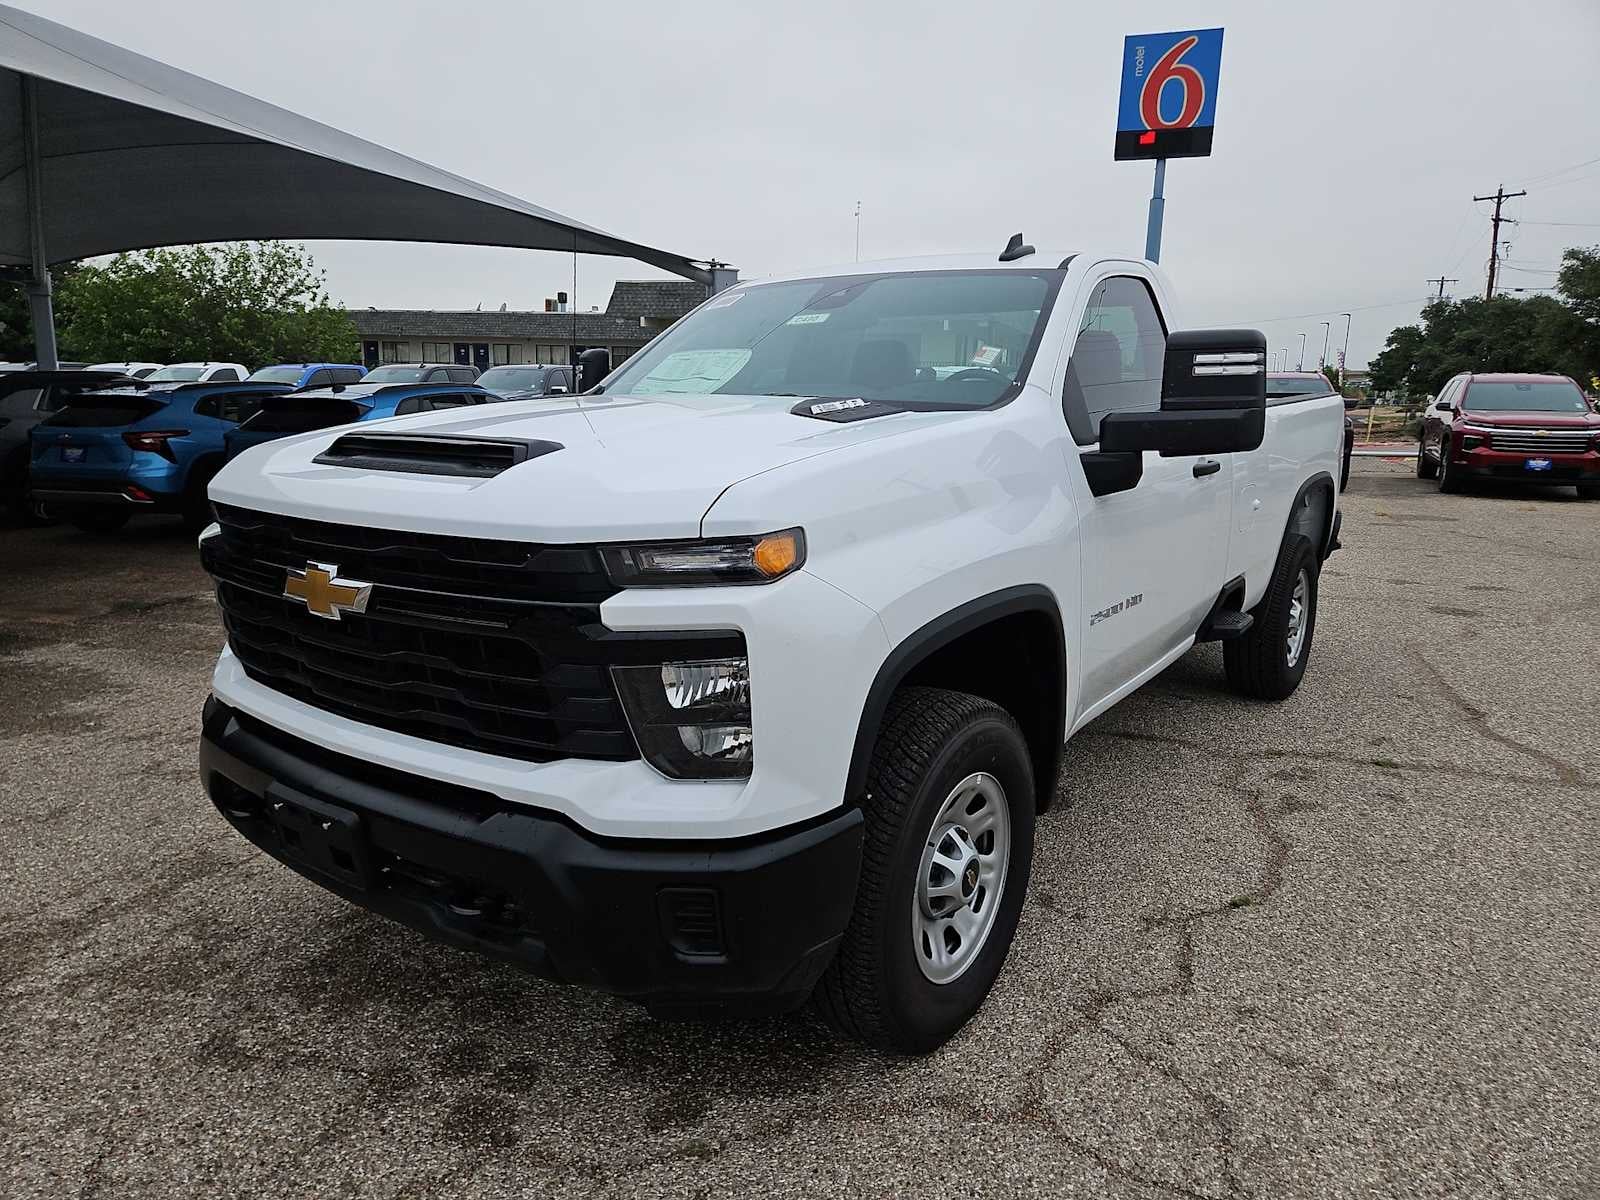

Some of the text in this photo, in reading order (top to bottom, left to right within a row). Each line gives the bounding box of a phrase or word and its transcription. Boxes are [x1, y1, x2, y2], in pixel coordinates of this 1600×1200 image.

[1135, 35, 1205, 130] motel 6
[1090, 593, 1143, 626] 2500 HD
